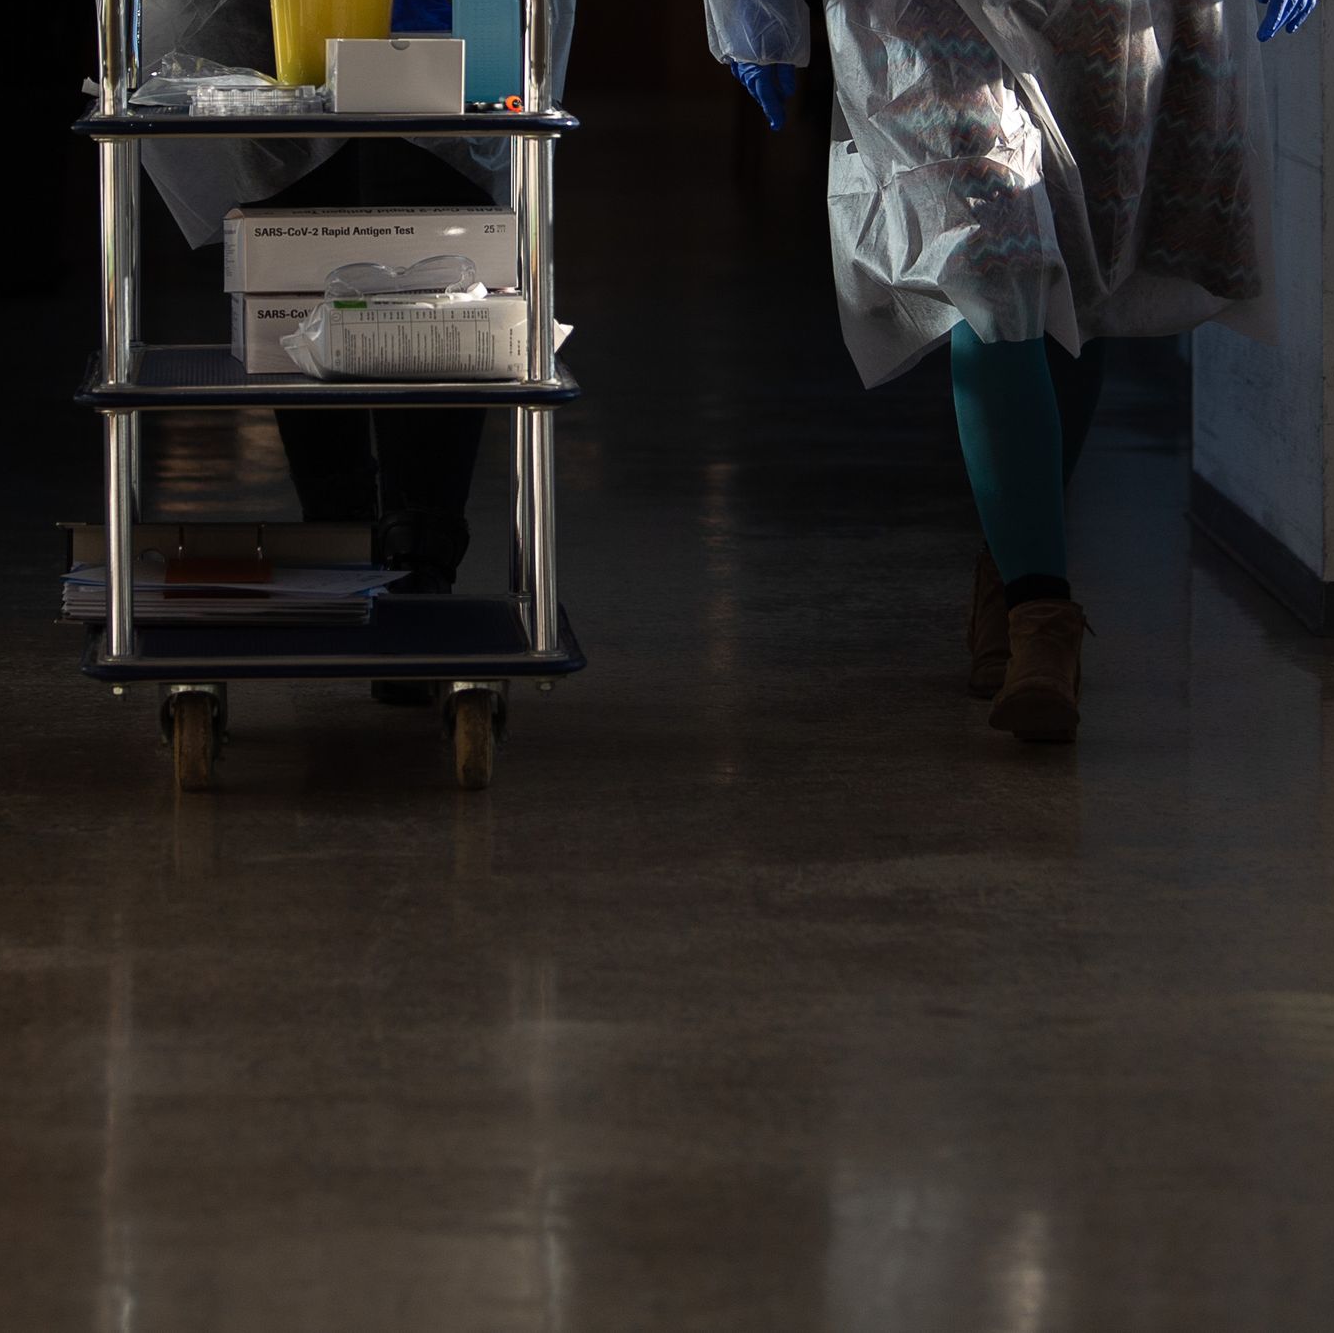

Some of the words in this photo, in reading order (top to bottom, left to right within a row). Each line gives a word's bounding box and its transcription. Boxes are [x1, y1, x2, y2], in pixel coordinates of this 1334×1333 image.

[254, 227, 319, 237] SARS-CoV-2
[322, 227, 350, 237] Rapid
[353, 226, 391, 237] Antigen
[394, 226, 414, 235] Test
[484, 224, 495, 234] 25
